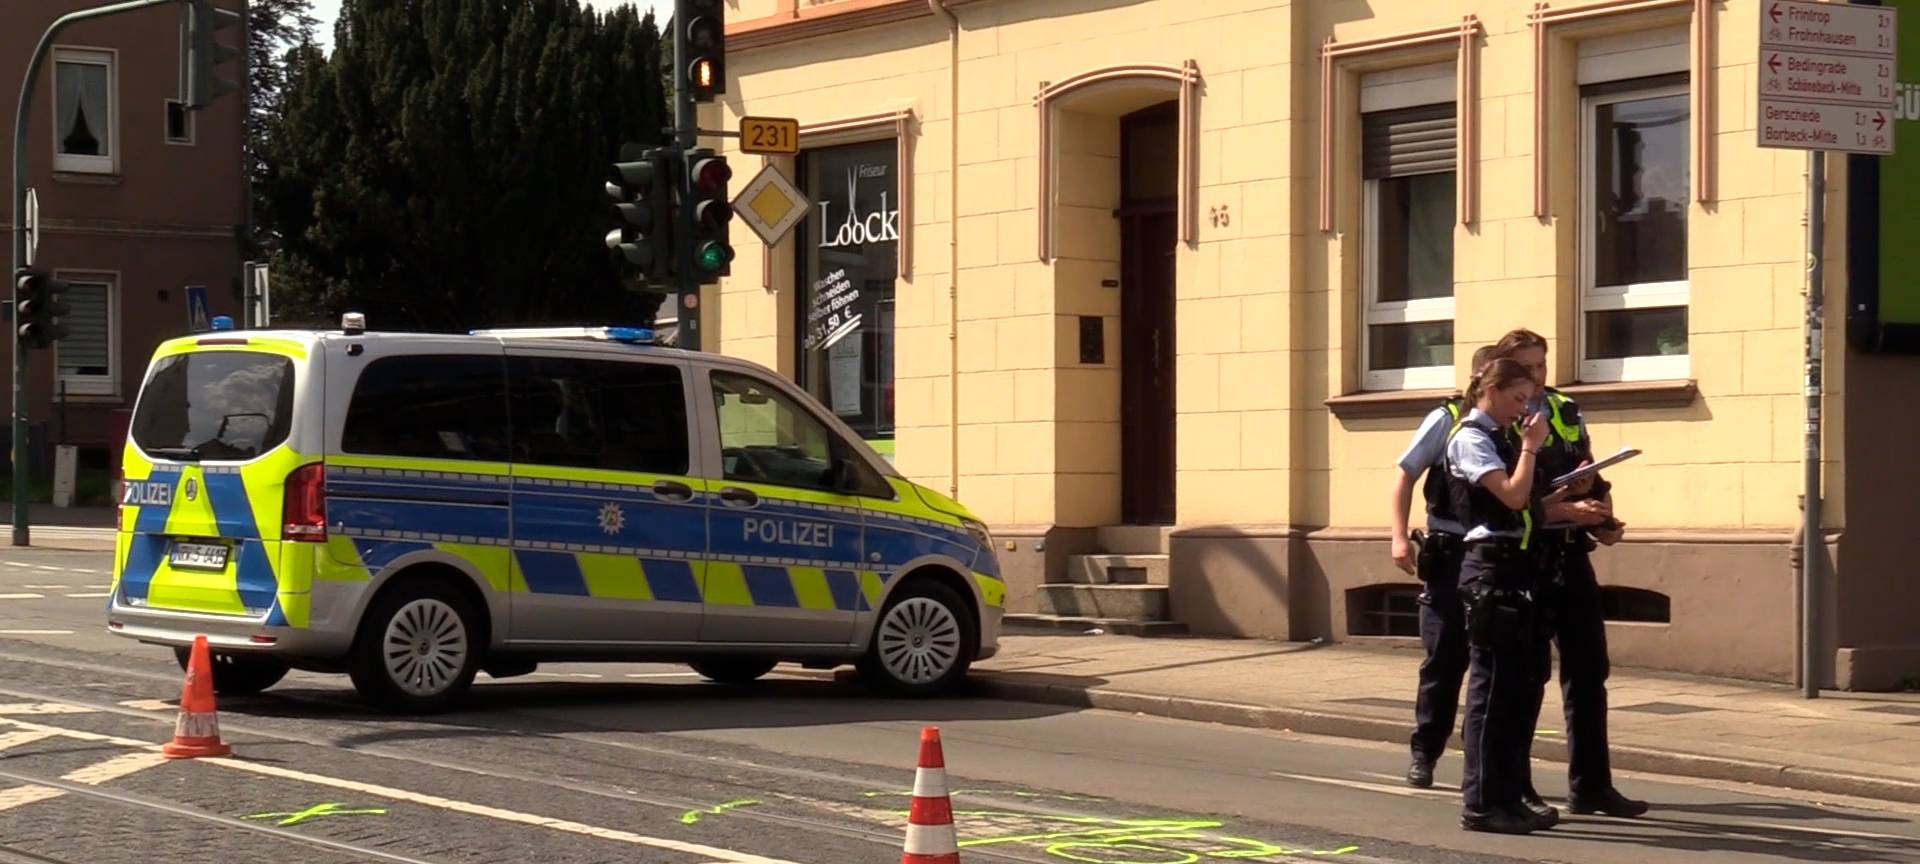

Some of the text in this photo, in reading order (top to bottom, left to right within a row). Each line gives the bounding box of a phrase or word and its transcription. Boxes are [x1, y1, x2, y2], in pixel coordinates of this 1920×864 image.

[1788, 6, 1830, 25] Frintrop
[1788, 26, 1857, 46] Frohnhausen
[1788, 56, 1847, 76] Bedingrade
[1788, 77, 1862, 96] Schönebeck-Mitte
[1765, 105, 1821, 123] Gerschede
[751, 124, 789, 148] 231
[1765, 126, 1838, 144] Borbeck-Mitte
[858, 164, 888, 178] Friseur
[817, 190, 900, 247] Loock
[812, 279, 851, 306] schneiden
[816, 313, 841, 340] 31,50
[844, 305, 854, 319] €
[743, 517, 834, 549] POLIZEI
